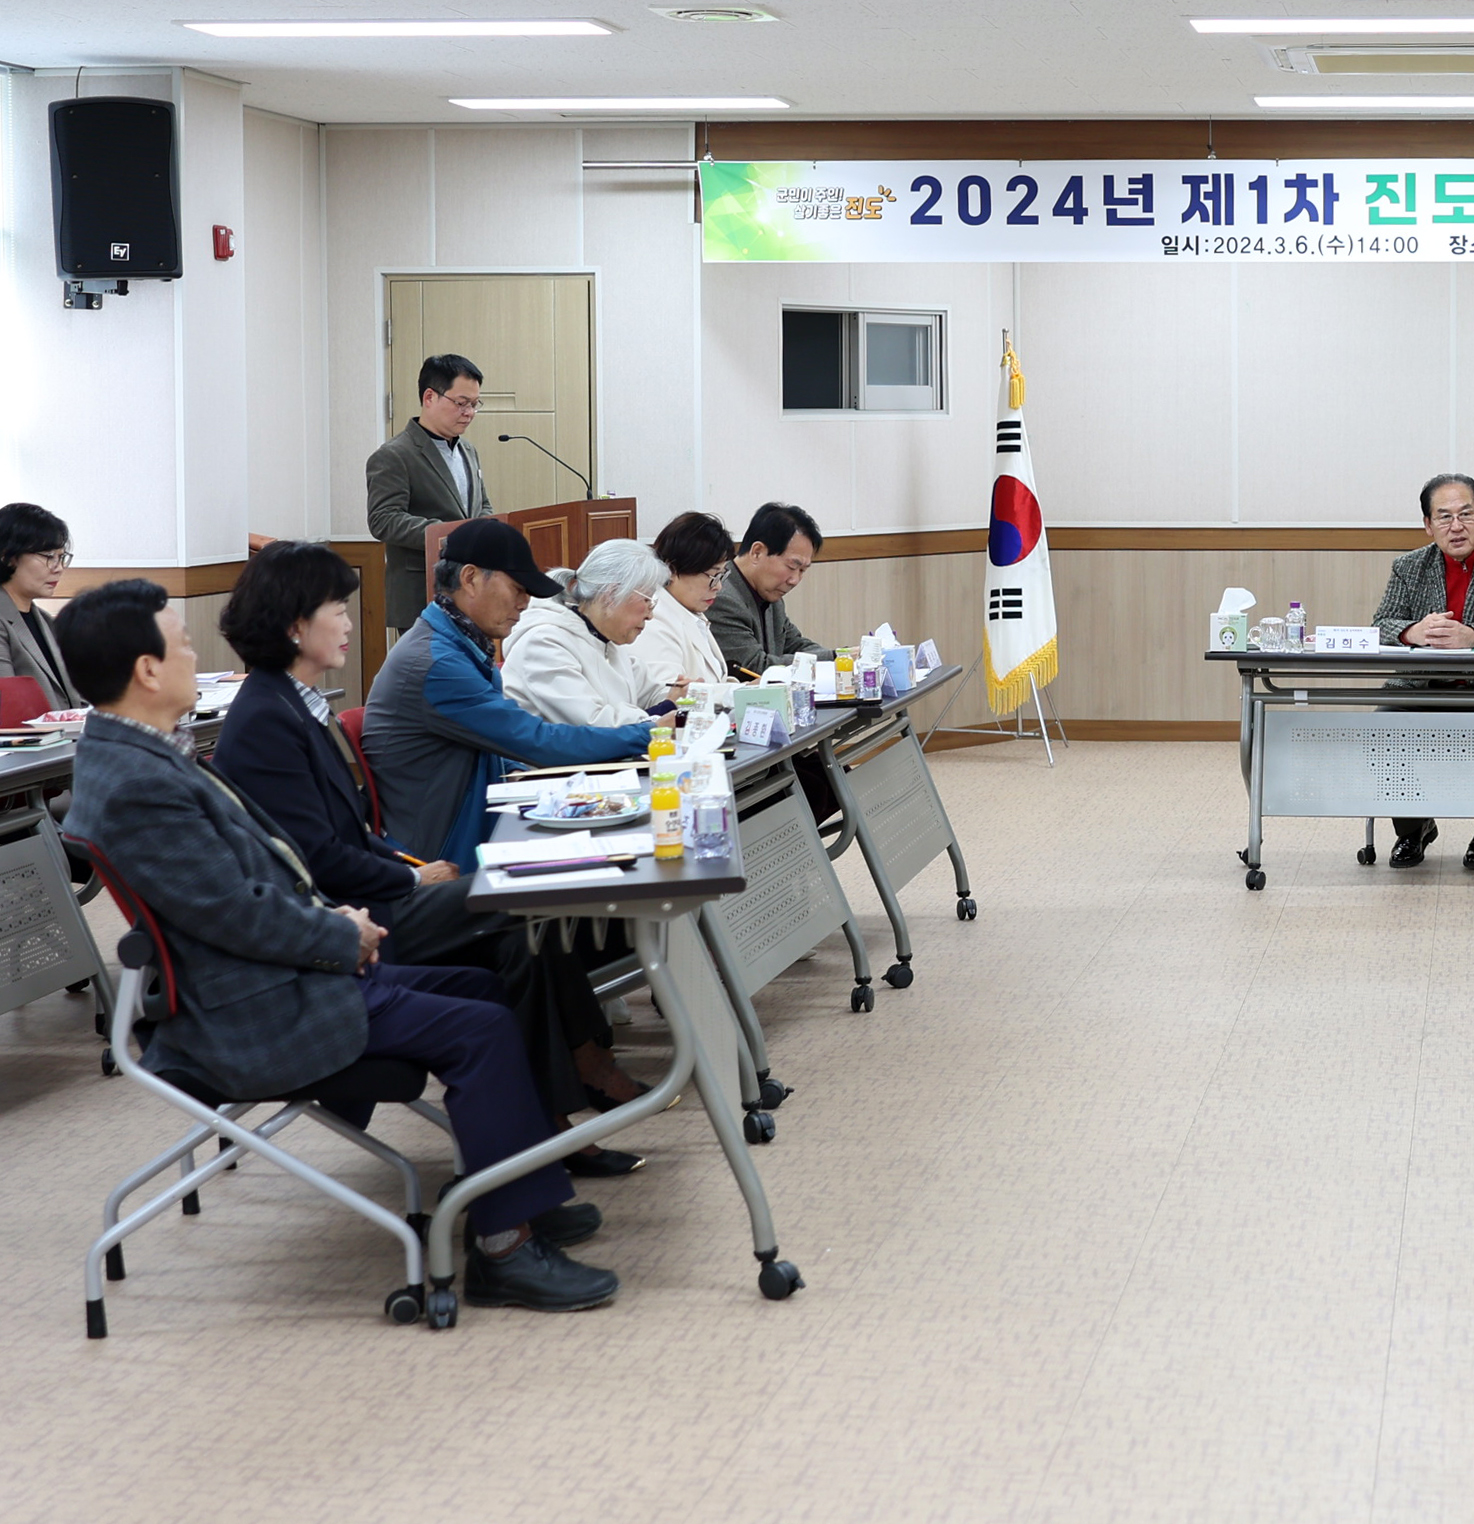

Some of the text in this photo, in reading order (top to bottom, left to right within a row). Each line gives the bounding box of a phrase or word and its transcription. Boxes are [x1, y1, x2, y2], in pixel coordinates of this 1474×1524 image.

[776, 187, 845, 203] 군민이 주인!
[793, 195, 884, 220] 살기좋은 진도
[909, 173, 1156, 226] 2024년
[1180, 173, 1340, 226] 제1차
